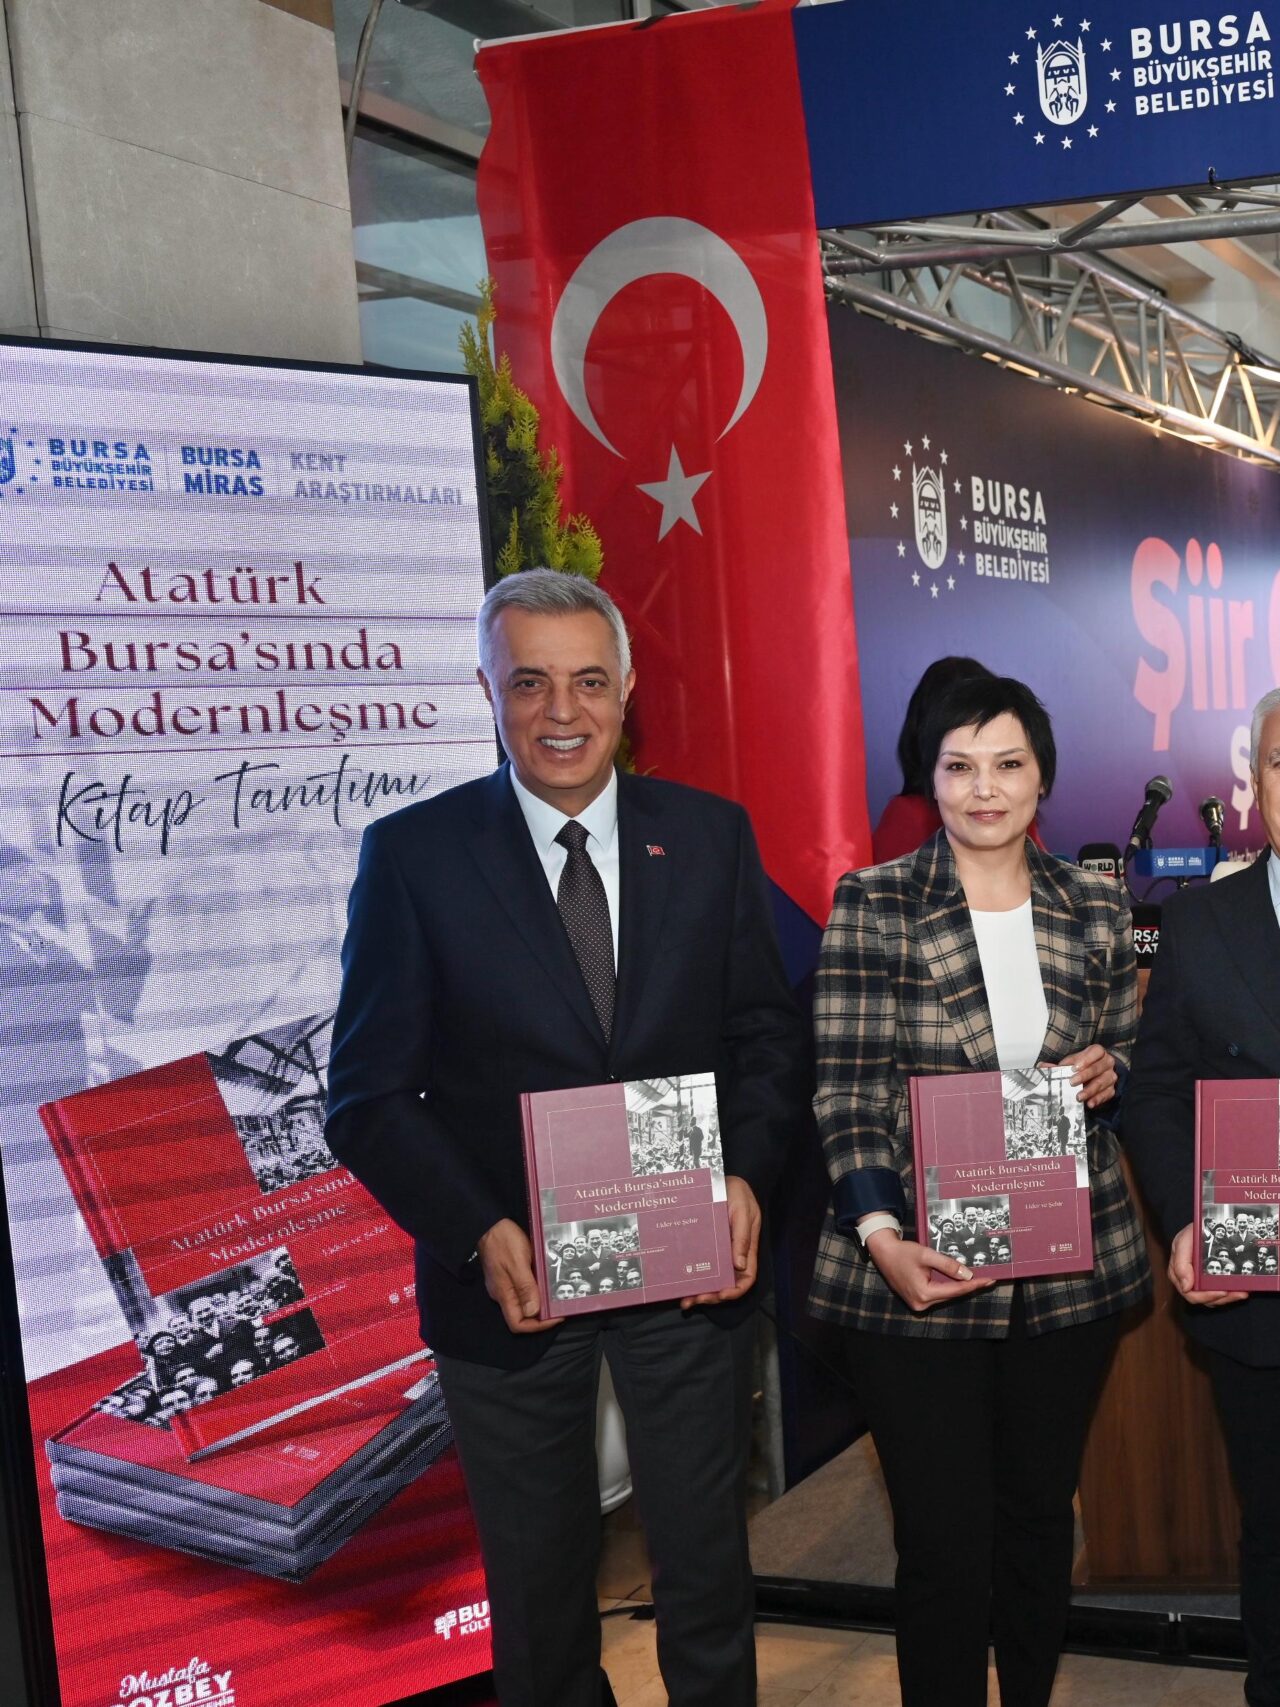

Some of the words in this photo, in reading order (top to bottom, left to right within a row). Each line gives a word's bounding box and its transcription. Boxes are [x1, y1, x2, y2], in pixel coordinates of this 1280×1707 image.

[1130, 10, 1272, 60] BURSA
[1133, 44, 1273, 88] BÜYÜKŞEHİR
[1135, 71, 1275, 115] BELEDİYESİ
[49, 438, 151, 461] BURSA
[181, 445, 262, 471] BURSA
[289, 451, 348, 472] KENT
[51, 458, 152, 477] BÜYÜKŞEHİR
[53, 474, 154, 492] BELEDİYESİ
[183, 472, 265, 496] MİRAS
[294, 480, 463, 506] ARAŞTIRMALARI
[971, 475, 1047, 526] BURSA
[974, 519, 1048, 556] BÜYÜKŞEHİR
[975, 551, 1050, 585] BELEDİYESİ
[95, 561, 327, 605] Atatürk
[1130, 536, 1255, 752] Şiir
[28, 690, 440, 742] Modernleşme
[56, 770, 206, 856] Kitap
[214, 753, 433, 829] Tanıtımı
[954, 1163, 996, 1179] Atatürk
[1229, 1174, 1268, 1184] Atatürk
[574, 1182, 621, 1201] Atatürk
[971, 1179, 1046, 1195] Modernleşme
[594, 1194, 678, 1214] Modernleşme
[120, 1656, 211, 1698] Mustafa
